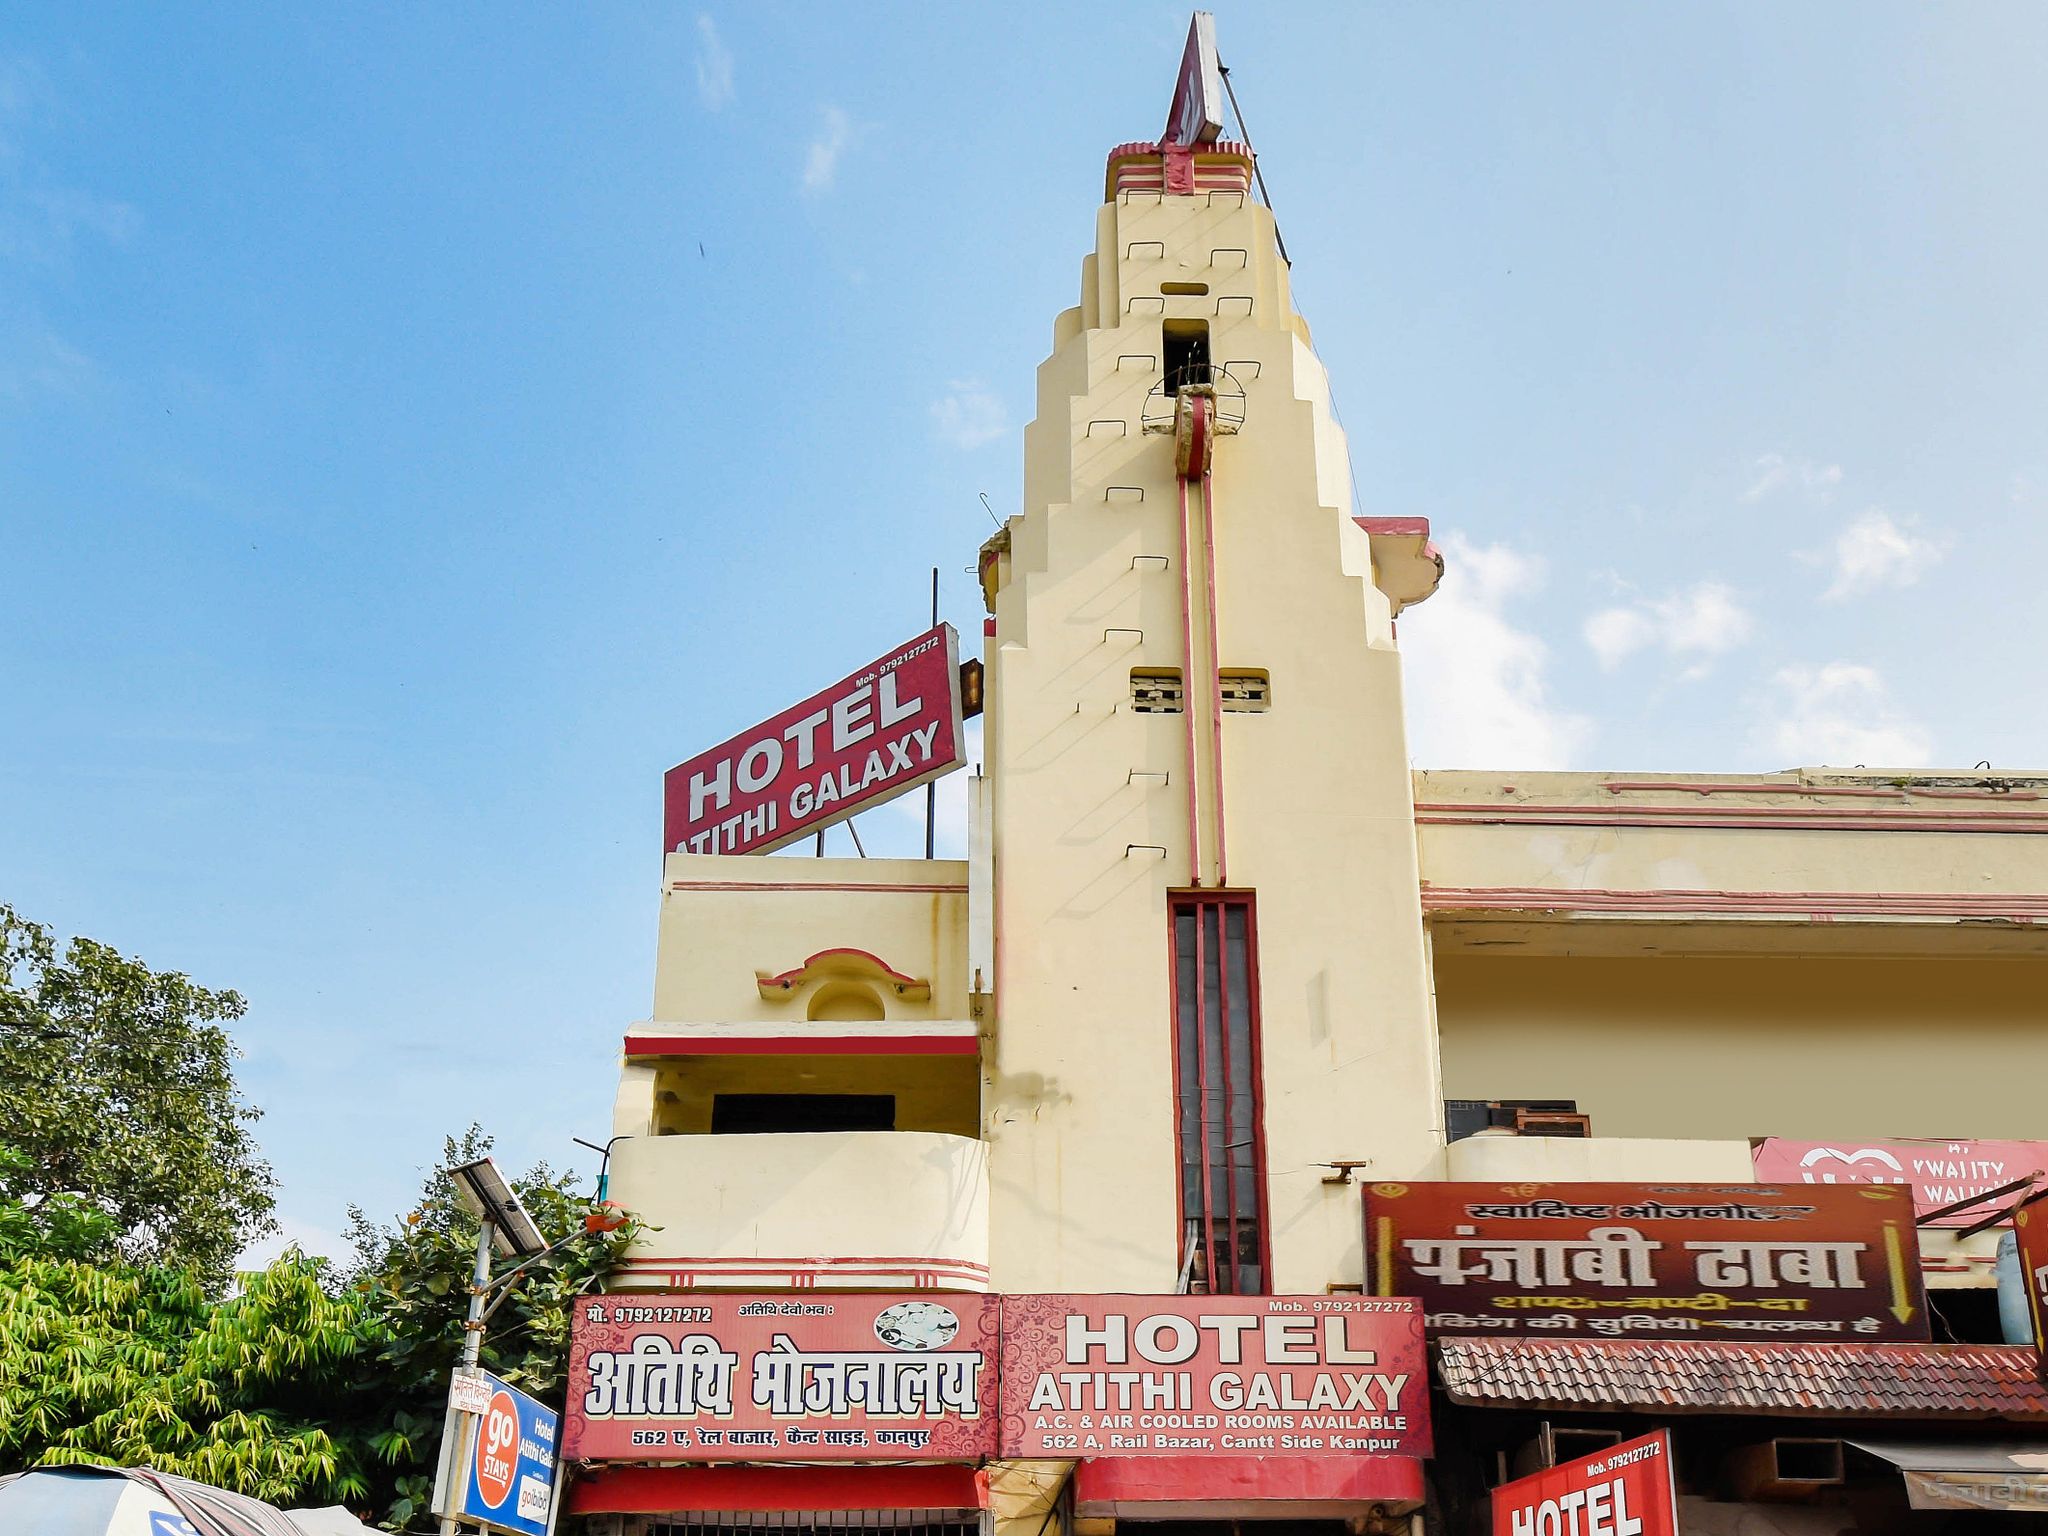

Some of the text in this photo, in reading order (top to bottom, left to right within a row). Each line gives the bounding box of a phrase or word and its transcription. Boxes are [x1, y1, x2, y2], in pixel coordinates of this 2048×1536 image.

[854, 636, 939, 688] Mob. 9792127272
[688, 671, 922, 823] HOTEL
[789, 720, 939, 820] GALAXY
[1465, 1199, 1611, 1220] स्वादिष्ट
[1402, 1224, 1867, 1290] पंजाबी ढाबा
[587, 1307, 712, 1323] मो. 9792127272
[738, 1302, 778, 1317] अतिथि
[780, 1302, 803, 1318] देवो
[1269, 1301, 1413, 1313] Mob. 9792127272
[1525, 1313, 1579, 1329] की
[1850, 1316, 1883, 1333] है
[1065, 1314, 1376, 1365] HOTEL
[585, 1333, 983, 1418] अतिथि भोजनालय
[1028, 1372, 1409, 1411] ATITHI GALAXY
[487, 1408, 514, 1455] go
[534, 1417, 555, 1443] Hotel
[632, 1429, 667, 1446] 562
[698, 1427, 722, 1446] रेल
[728, 1429, 779, 1448] बाजार,
[786, 1427, 819, 1446] कैन्ट
[824, 1429, 868, 1448] साइड,
[875, 1429, 930, 1449] कानपुर
[1034, 1415, 1407, 1430] A.C. & AIR COOLED ROOMS AVAILABLE
[519, 1437, 556, 1469] Atithi Gala
[1041, 1435, 1400, 1453] 562 A, Rail Bazar, Cantt Side Kanpur
[1587, 1441, 1660, 1478] Mob. 9792127272
[483, 1455, 510, 1481] STAYS
[1511, 1477, 1642, 1536] HOTEL
